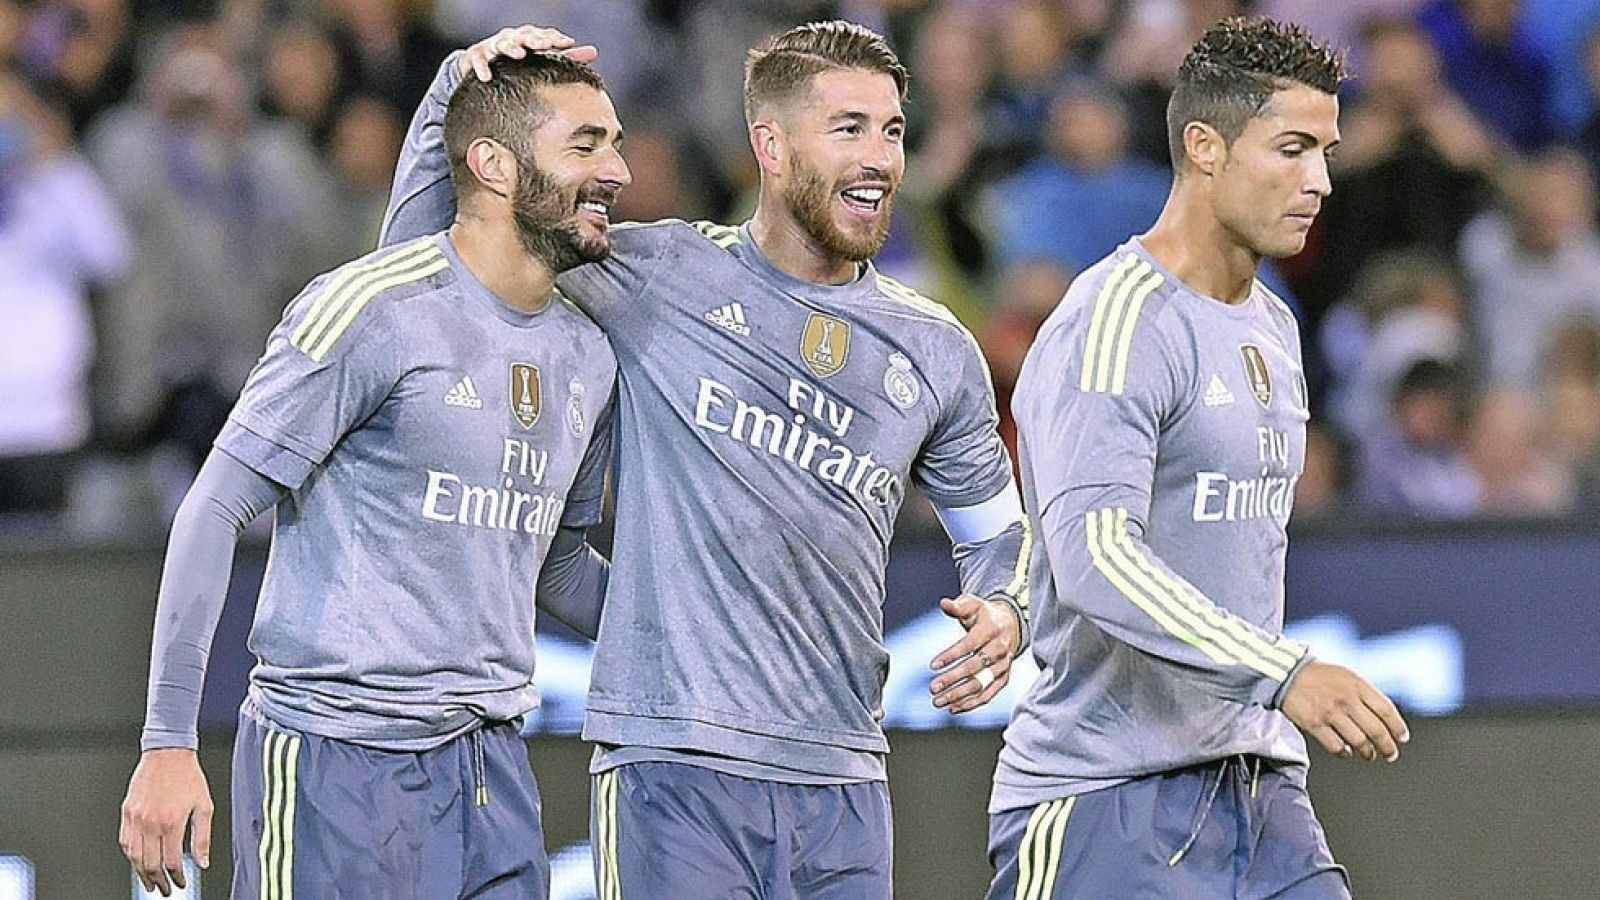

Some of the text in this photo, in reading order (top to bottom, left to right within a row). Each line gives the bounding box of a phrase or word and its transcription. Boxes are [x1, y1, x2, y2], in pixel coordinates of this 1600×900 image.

[788, 377, 854, 437] Fly
[502, 438, 548, 486] Fly
[695, 376, 900, 506] Emirates
[1257, 426, 1289, 469] Fly
